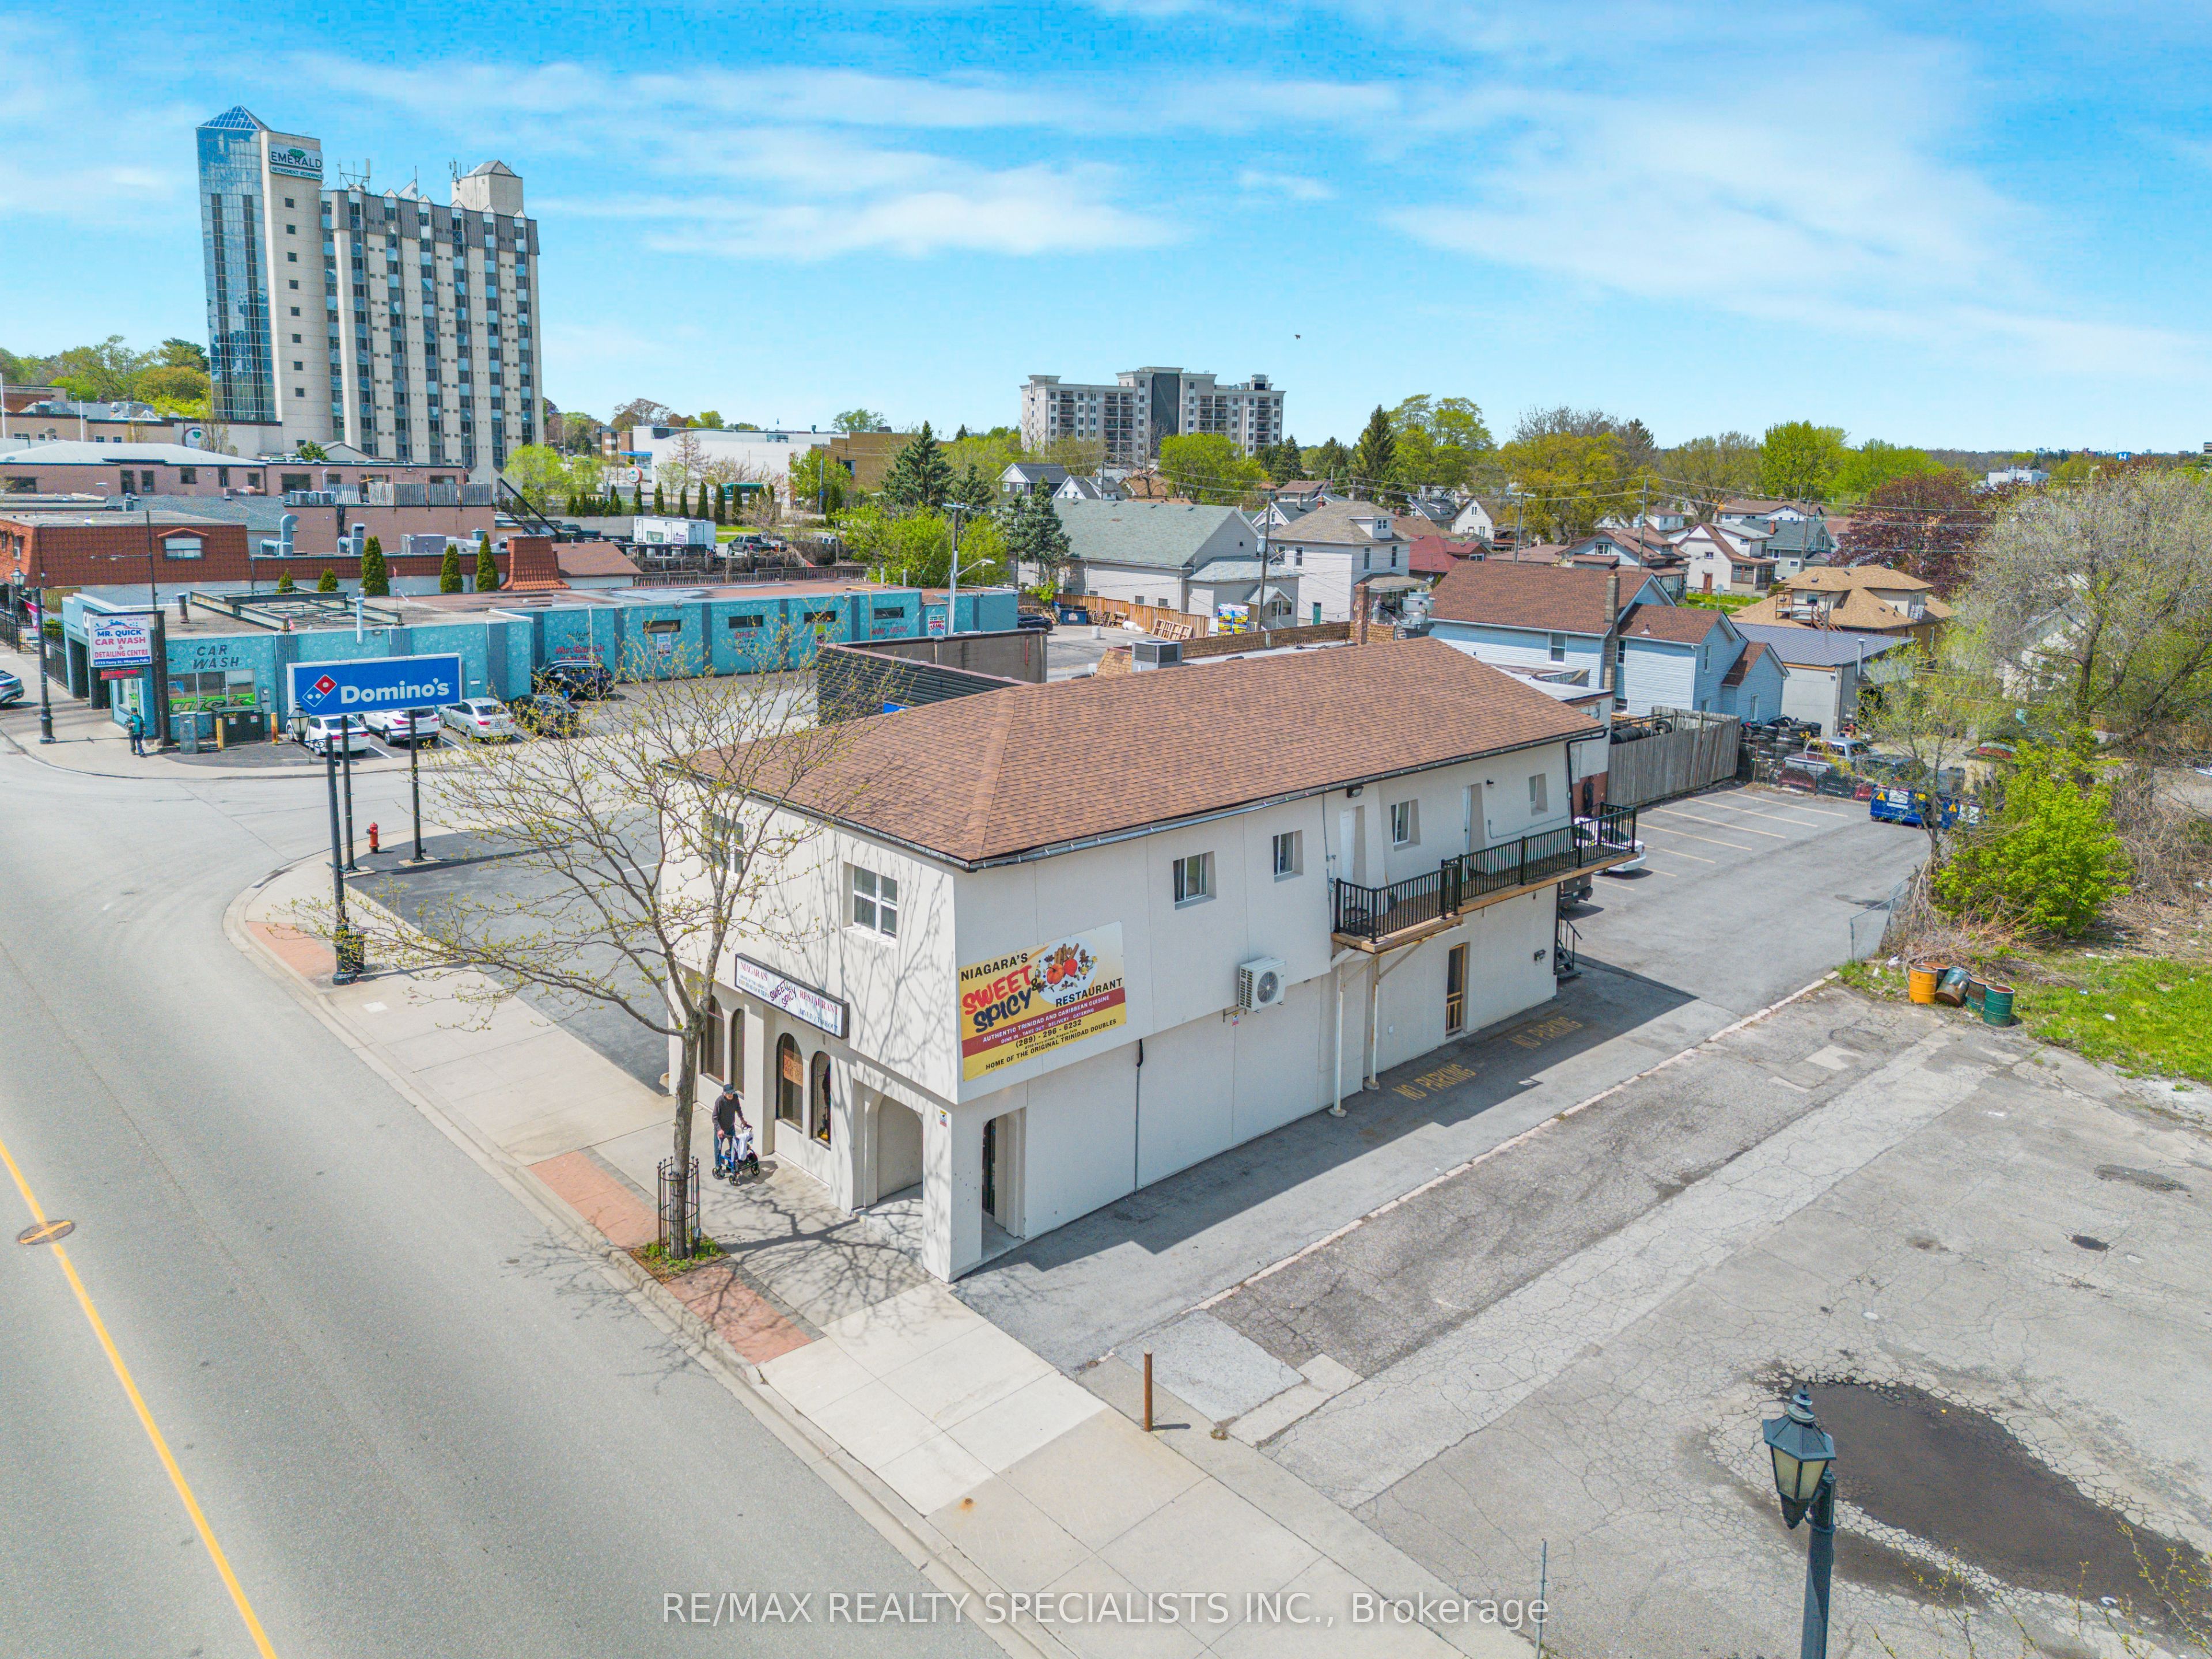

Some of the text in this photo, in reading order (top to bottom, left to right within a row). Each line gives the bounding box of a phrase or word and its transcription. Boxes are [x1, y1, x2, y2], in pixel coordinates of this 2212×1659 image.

[271, 151, 322, 168] EMERALD
[272, 166, 298, 175] RETIREMENT
[192, 657, 239, 669] WASH
[196, 645, 228, 656] CAR
[340, 678, 449, 704] Domino's
[961, 953, 1028, 981] NIAGARA'S
[770, 979, 786, 1001] SWEET
[782, 987, 796, 1007] SPICY
[800, 990, 839, 1015] RESTAURANT
[962, 965, 1043, 1015] SWEET &
[1056, 978, 1122, 1007] RESTAURANT
[973, 987, 1032, 1033] SPICY
[983, 1027, 1016, 1043] AUTHENTIC
[1017, 1017, 1044, 1031] TRINIDAD
[1058, 1002, 1088, 1017] CARIBBEAN
[1089, 995, 1110, 1006] CUISINE
[1048, 1017, 1069, 1027] DELIVERY
[1073, 1008, 1094, 1018] CATERING
[986, 1059, 1004, 1070] HOME
[1016, 1050, 1028, 1058] THE
[1030, 1040, 1059, 1054] ORIGINAL
[1061, 1029, 1089, 1042] TRINIDAD
[1090, 1019, 1116, 1032] DOUBLES
[1016, 1035, 1036, 1048] (289)
[1043, 1028, 1057, 1038] 296
[1063, 1019, 1082, 1031] 6232
[1510, 1016, 1583, 1050] NO PARKING
[1392, 1064, 1476, 1101] NO PARKING
